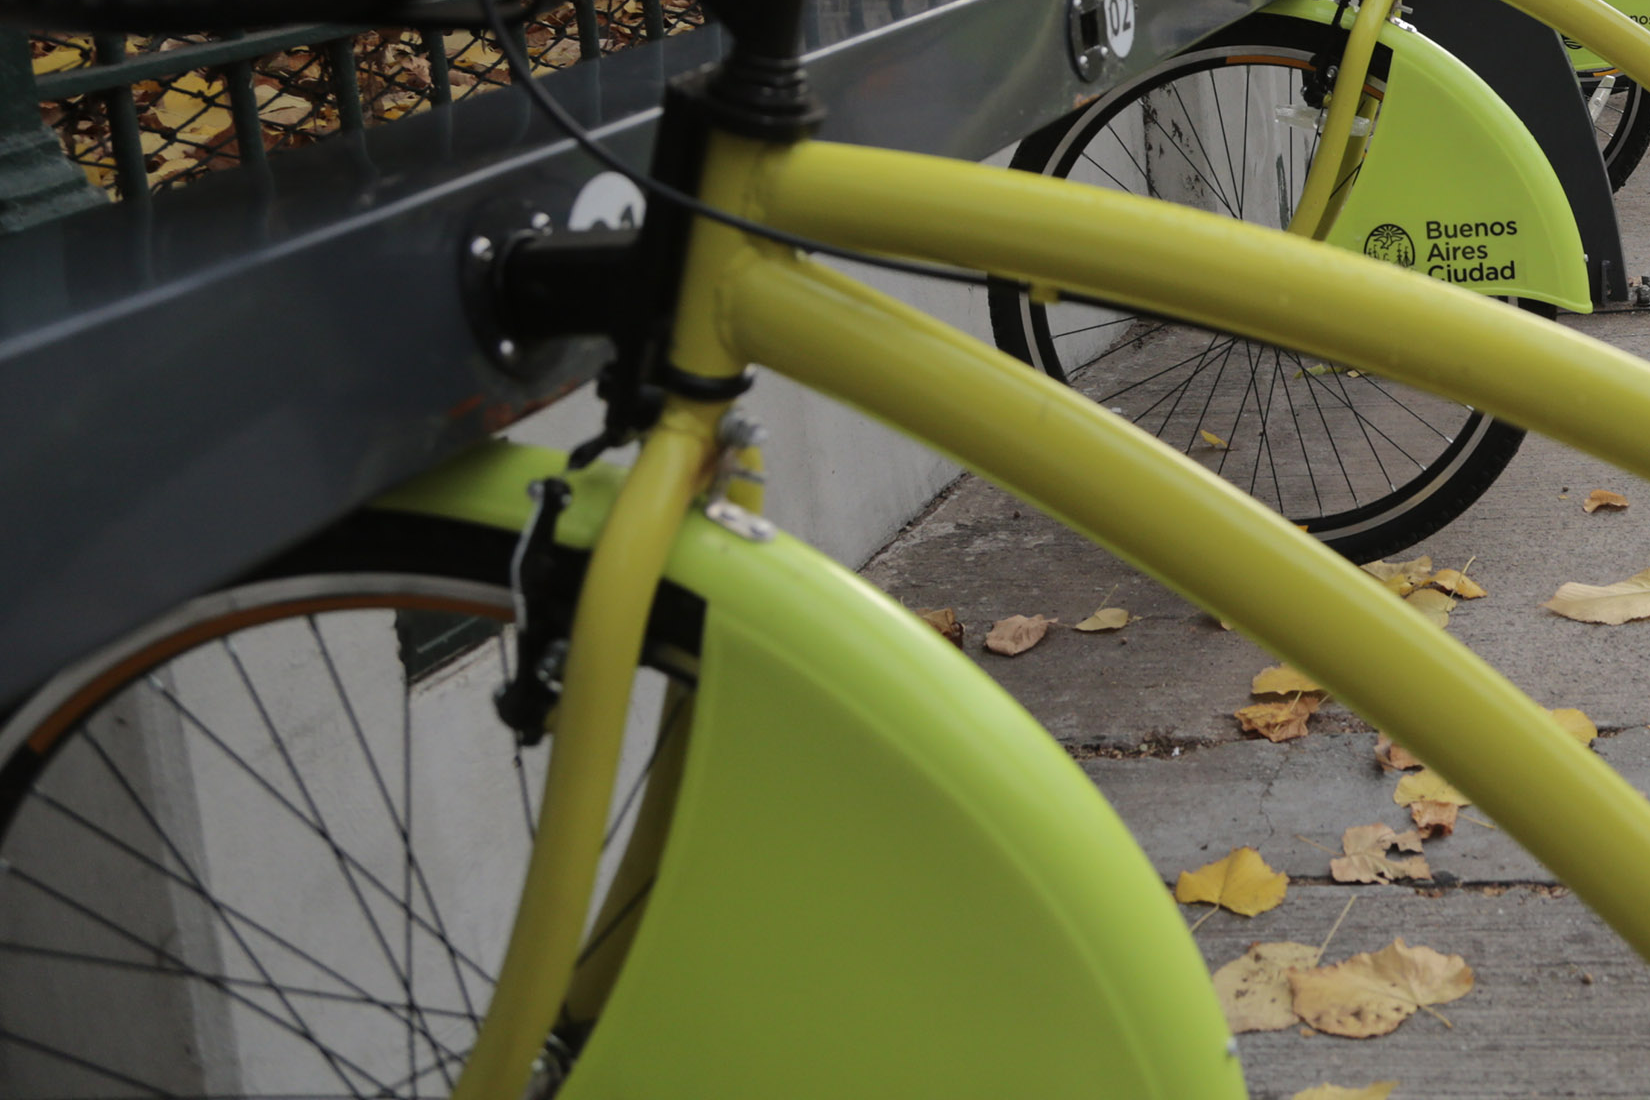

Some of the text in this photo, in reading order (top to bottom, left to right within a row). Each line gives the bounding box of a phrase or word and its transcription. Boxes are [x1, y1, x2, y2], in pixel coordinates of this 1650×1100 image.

[1426, 220, 1518, 240] Buenos
[1427, 242, 1488, 262] Aires
[1428, 260, 1516, 283] Ciudad
